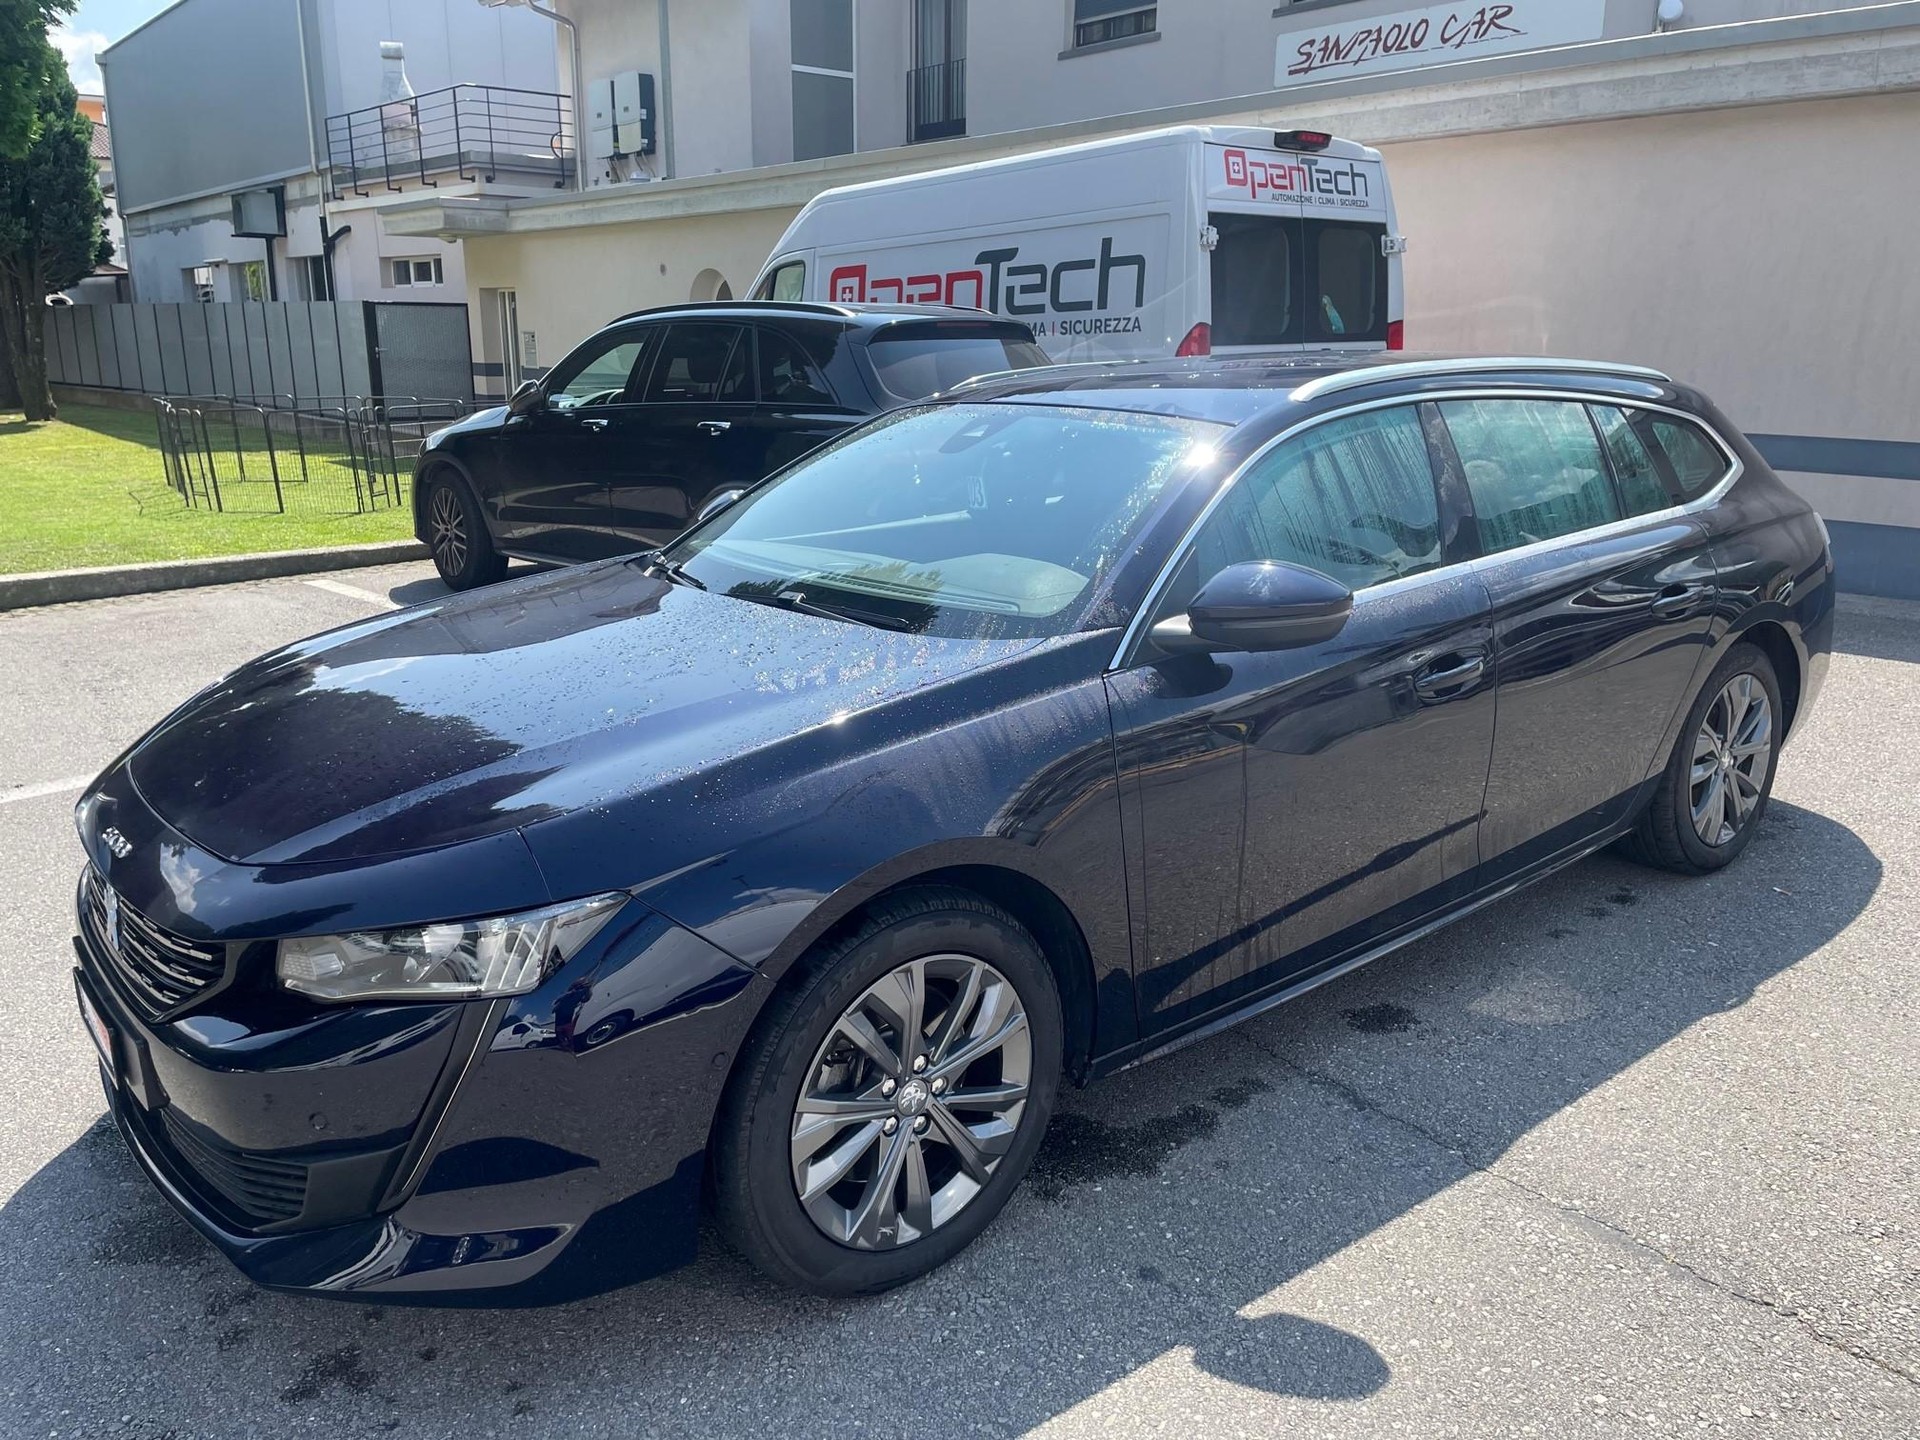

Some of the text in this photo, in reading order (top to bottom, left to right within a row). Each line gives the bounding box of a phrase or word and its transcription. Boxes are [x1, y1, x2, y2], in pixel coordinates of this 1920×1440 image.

[1288, 5, 1521, 74] SANPAOLO CAR
[1224, 149, 1368, 199] OpenTech
[1271, 193, 1369, 208] AUTOMAZIONE CLIMA SICUREZZA
[1060, 316, 1142, 336] SICUREZZA
